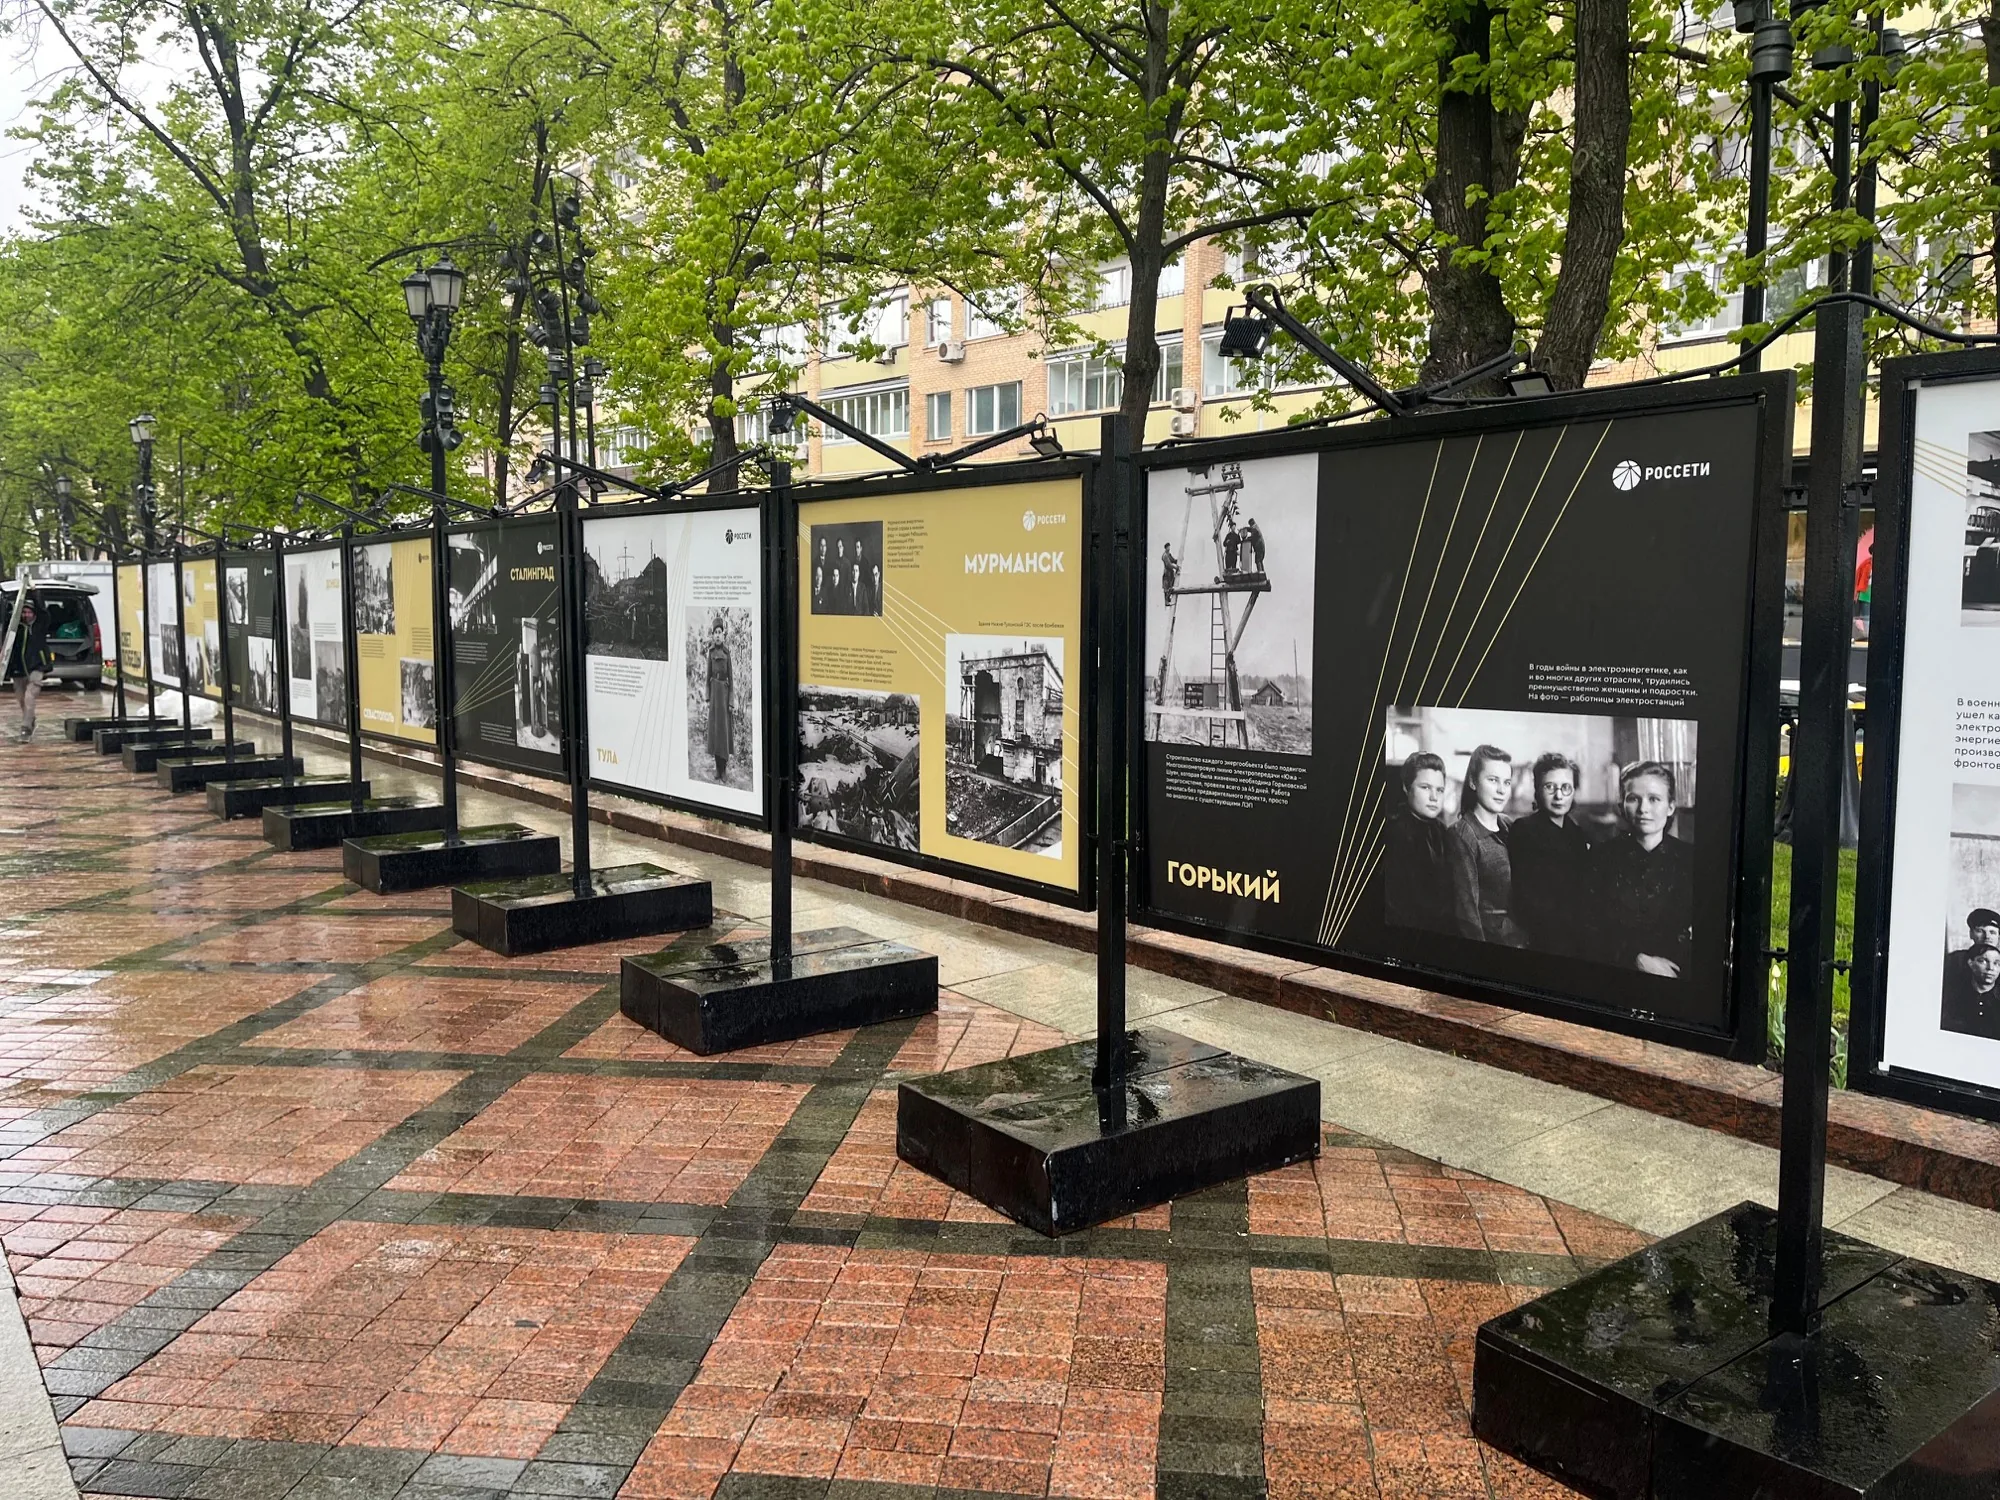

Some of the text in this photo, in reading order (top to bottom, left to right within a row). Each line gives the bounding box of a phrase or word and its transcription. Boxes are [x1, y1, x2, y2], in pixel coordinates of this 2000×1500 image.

[1645, 462, 1710, 481] РОССЕТИ
[1037, 514, 1066, 525] РОССЕТИ
[964, 551, 1065, 574] МУРМАНСК
[510, 566, 555, 582] СТАЛИНГРАД
[1529, 663, 1535, 671] В
[1556, 663, 1580, 672] войны
[1588, 666, 1671, 675] электроэнергетике,
[1574, 676, 1602, 684] других
[1603, 677, 1644, 685] отраслях,
[1646, 678, 1691, 686] трудились
[1528, 684, 1600, 692] преимущественно
[1649, 688, 1698, 697] подростки.
[1540, 692, 1559, 701] фото
[1570, 694, 1614, 704] работницы
[1616, 698, 1685, 707] электростанций
[1957, 697, 1964, 706] В
[1956, 711, 2000, 721] ушел ка
[1955, 723, 2000, 734] электро
[1955, 735, 2000, 746] энергие
[596, 747, 618, 765] ТУЛА
[1954, 748, 2000, 758] произво
[1264, 762, 1279, 771] было
[1271, 788, 1291, 797] Работа
[1167, 860, 1280, 904] ГОРЬКИЙ
